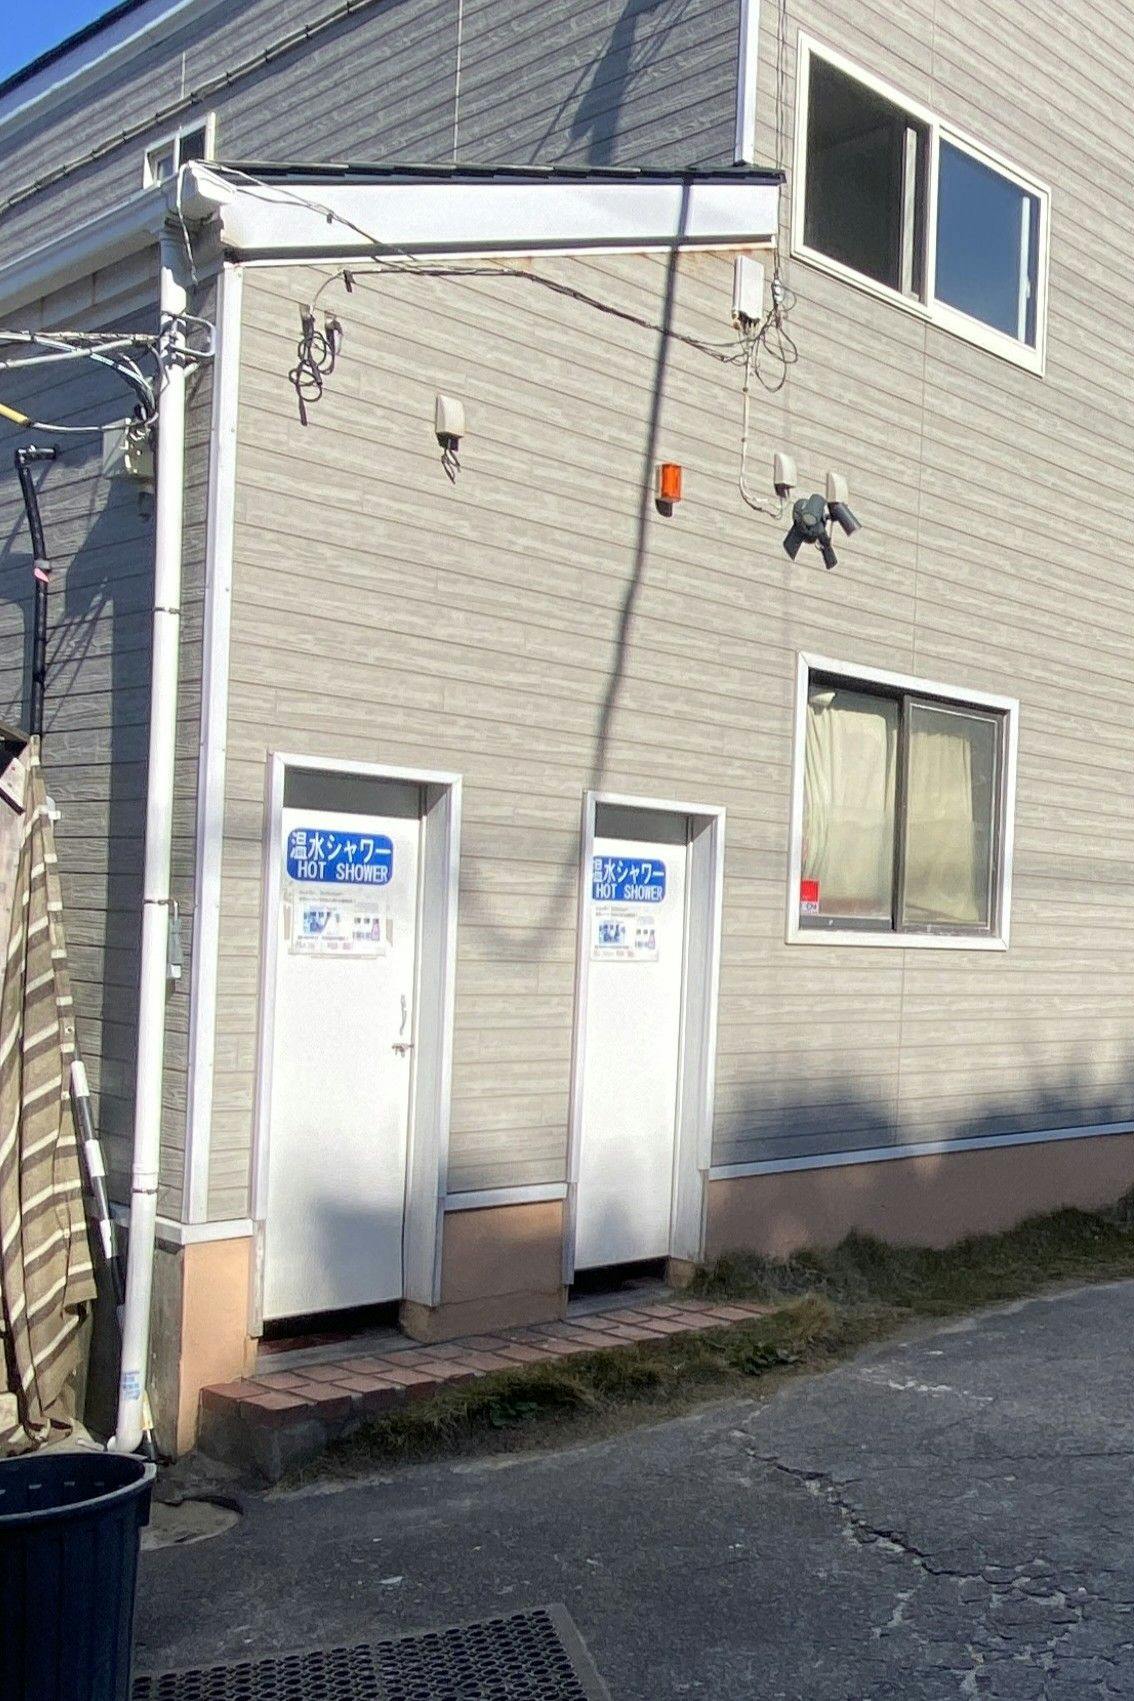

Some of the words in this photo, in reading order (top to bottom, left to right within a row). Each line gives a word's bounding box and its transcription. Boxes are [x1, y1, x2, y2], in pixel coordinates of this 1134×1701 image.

[290, 831, 391, 863] 温水シャワー
[297, 861, 326, 879] HOT
[336, 862, 389, 882] SHOWER
[596, 883, 618, 899] HOT
[624, 885, 663, 901] SHOWER
